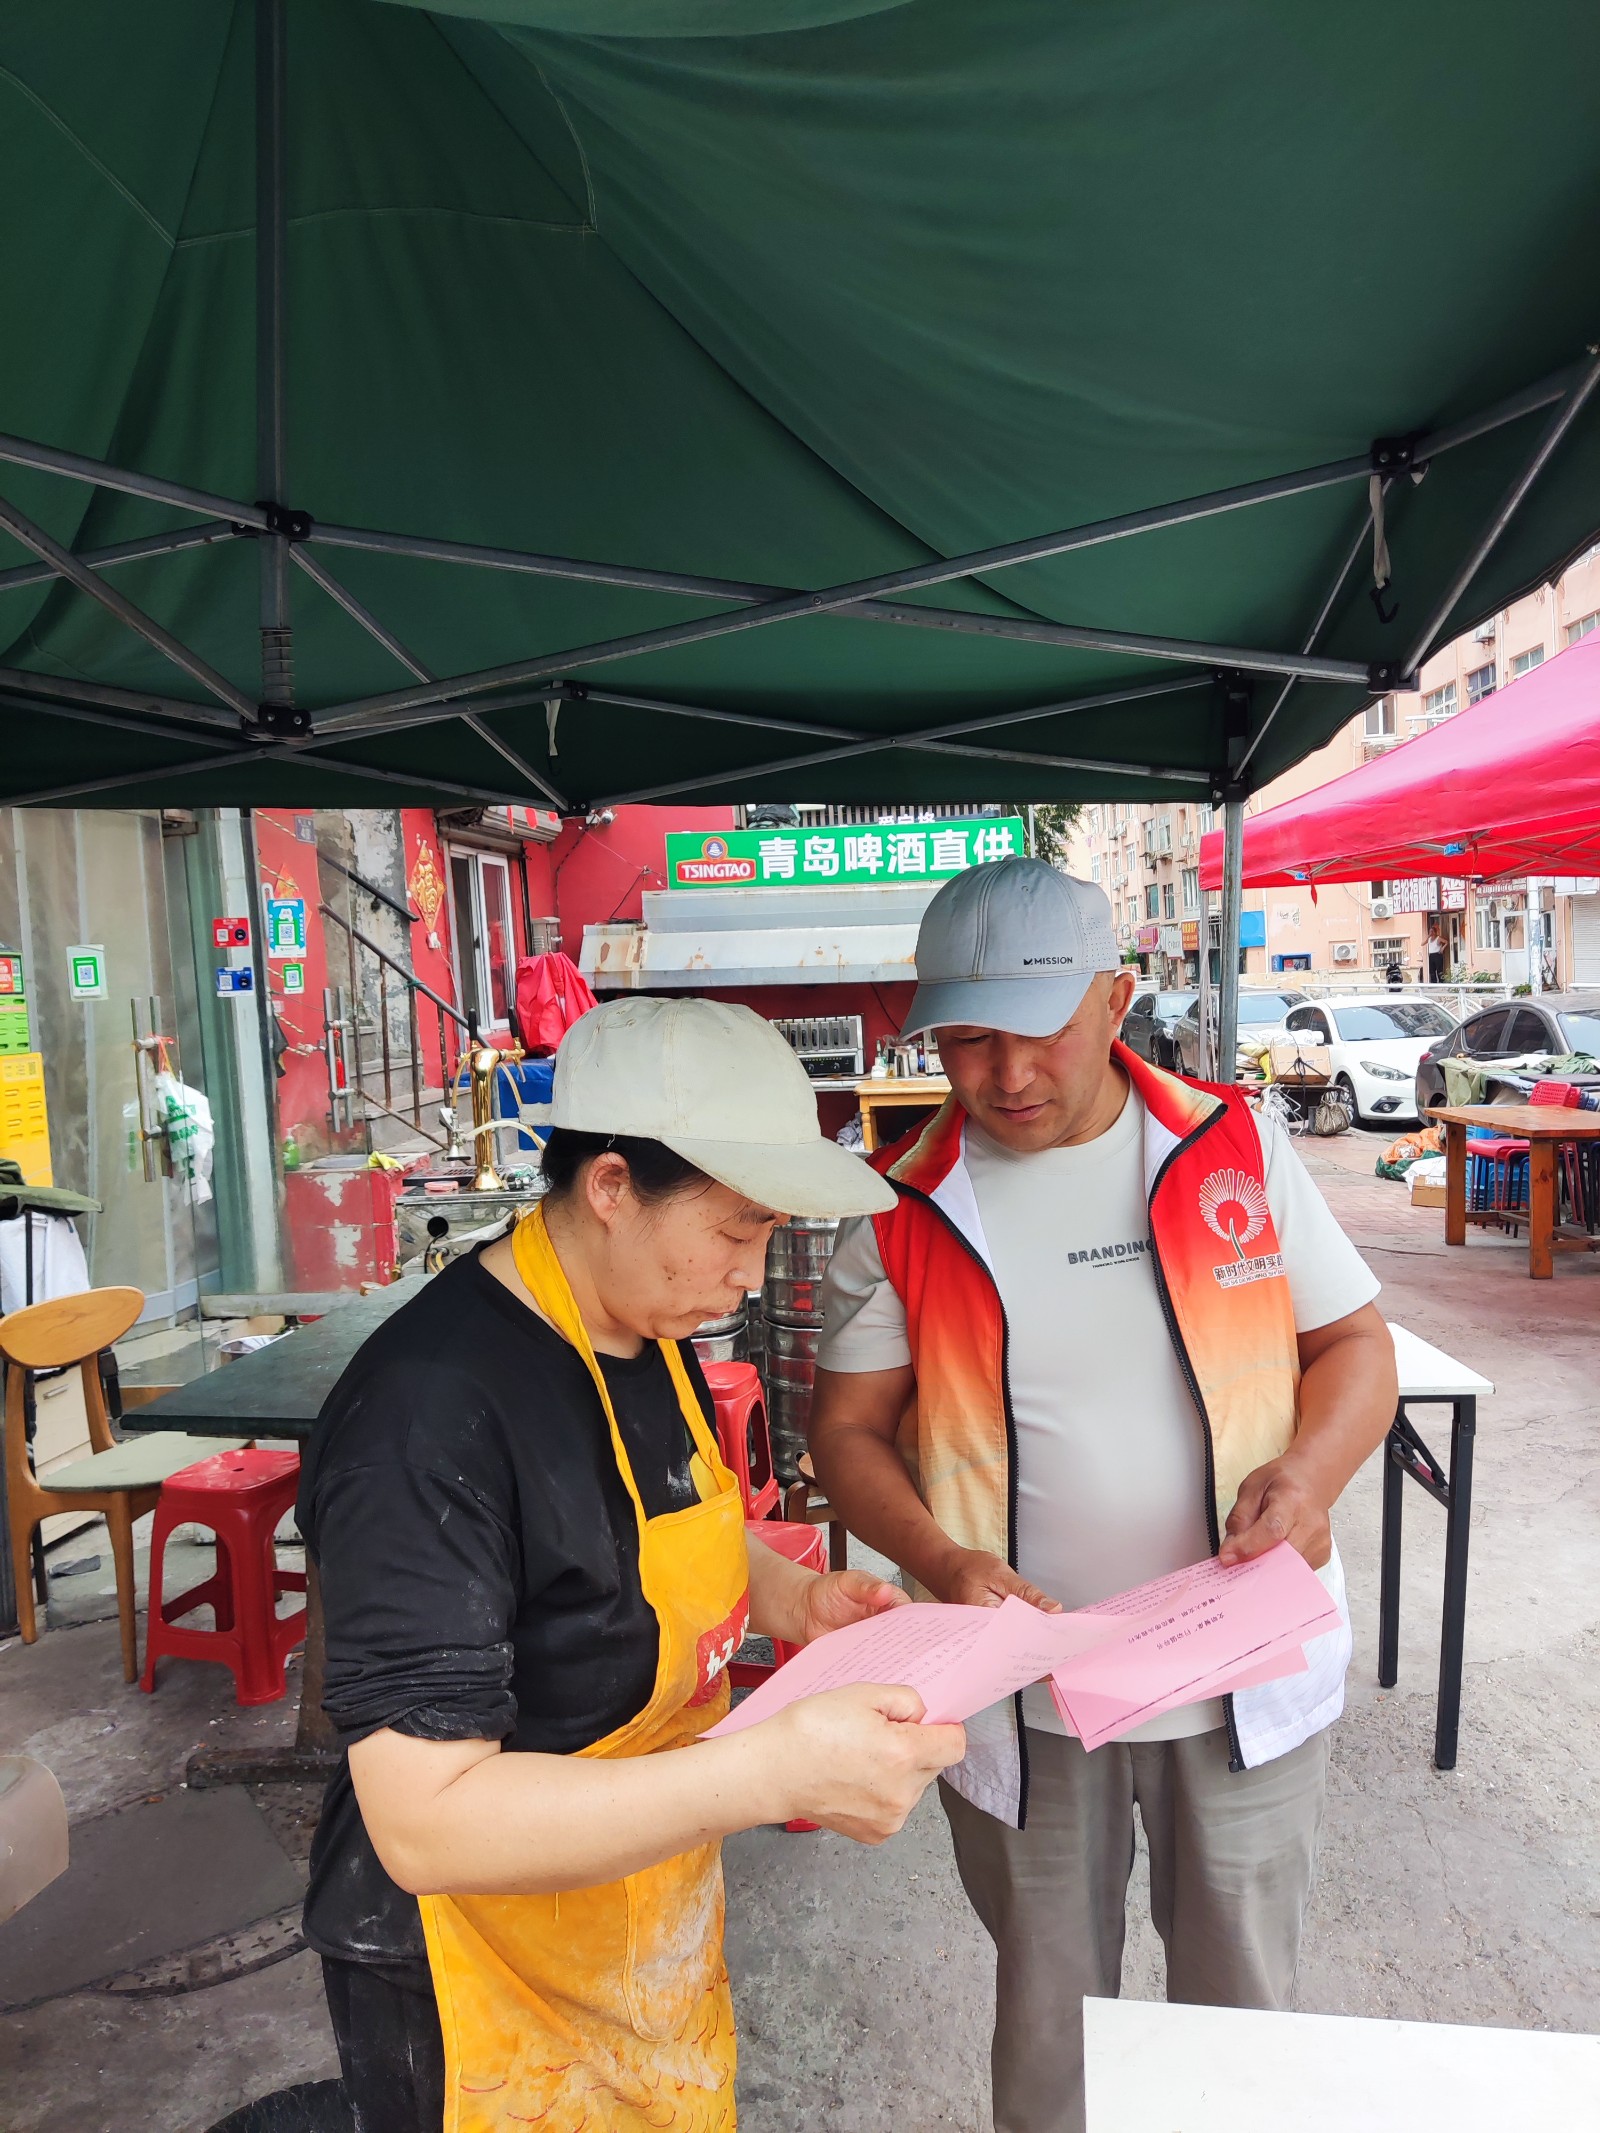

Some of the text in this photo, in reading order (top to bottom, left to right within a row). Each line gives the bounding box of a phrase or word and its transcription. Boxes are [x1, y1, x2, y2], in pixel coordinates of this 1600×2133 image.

[758, 827, 1015, 880] 青岛啤酒直供
[681, 863, 751, 878] TSINGTAO
[1034, 957, 1073, 965] MISSION
